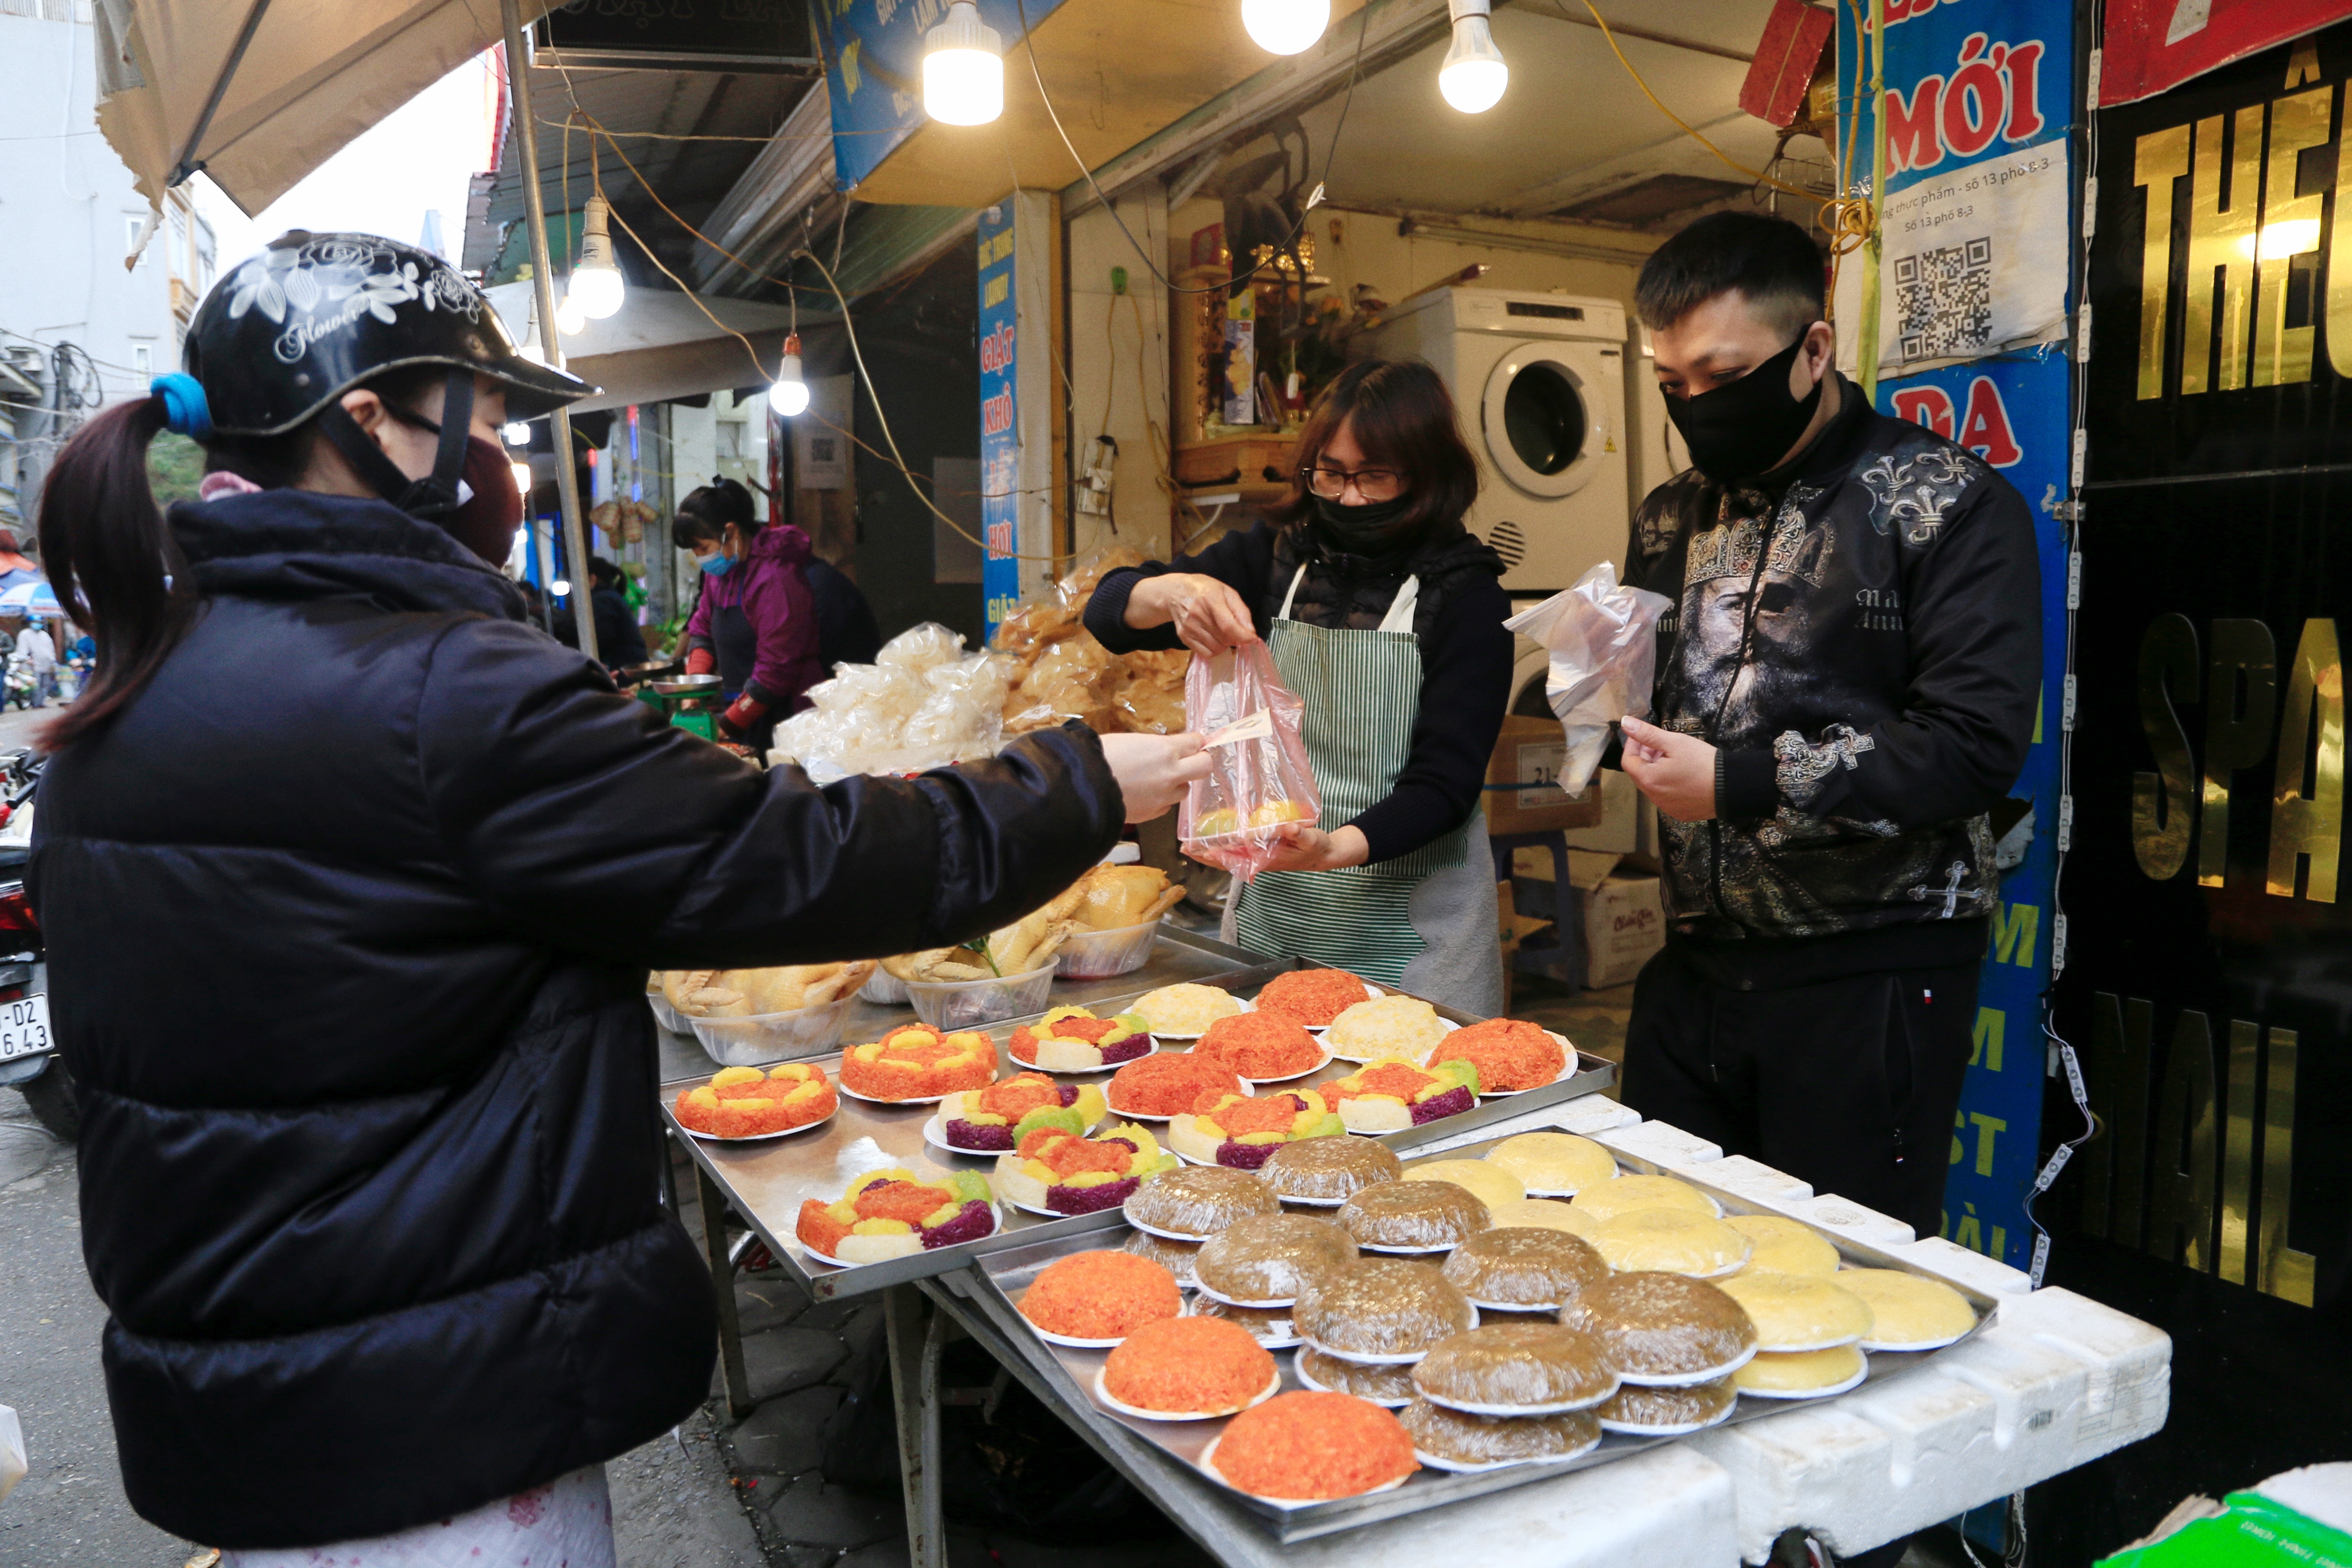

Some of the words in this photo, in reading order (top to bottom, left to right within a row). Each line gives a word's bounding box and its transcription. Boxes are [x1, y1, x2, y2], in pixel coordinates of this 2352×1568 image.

[1873, 32, 2045, 179] MỚI
[1896, 198, 1919, 214] thực
[1922, 187, 1955, 207] phẩm
[1966, 177, 1979, 191] số
[1983, 173, 1997, 186] 13
[2001, 164, 2026, 184] phố
[2029, 158, 2049, 173] 8-3
[1905, 219, 1917, 232] Số
[1920, 218, 1932, 228] 13
[1935, 209, 1954, 227] phố
[1958, 205, 1974, 218] 8-3
[982, 320, 1015, 376] GIẶT
[984, 381, 1013, 435] KHÔ
[988, 519, 1013, 560] HƠI
[2132, 612, 2345, 903] SPA
[0, 1001, 36, 1026] -D2
[4, 1025, 47, 1055] 6.43
[2082, 991, 2317, 1308] NAIL
